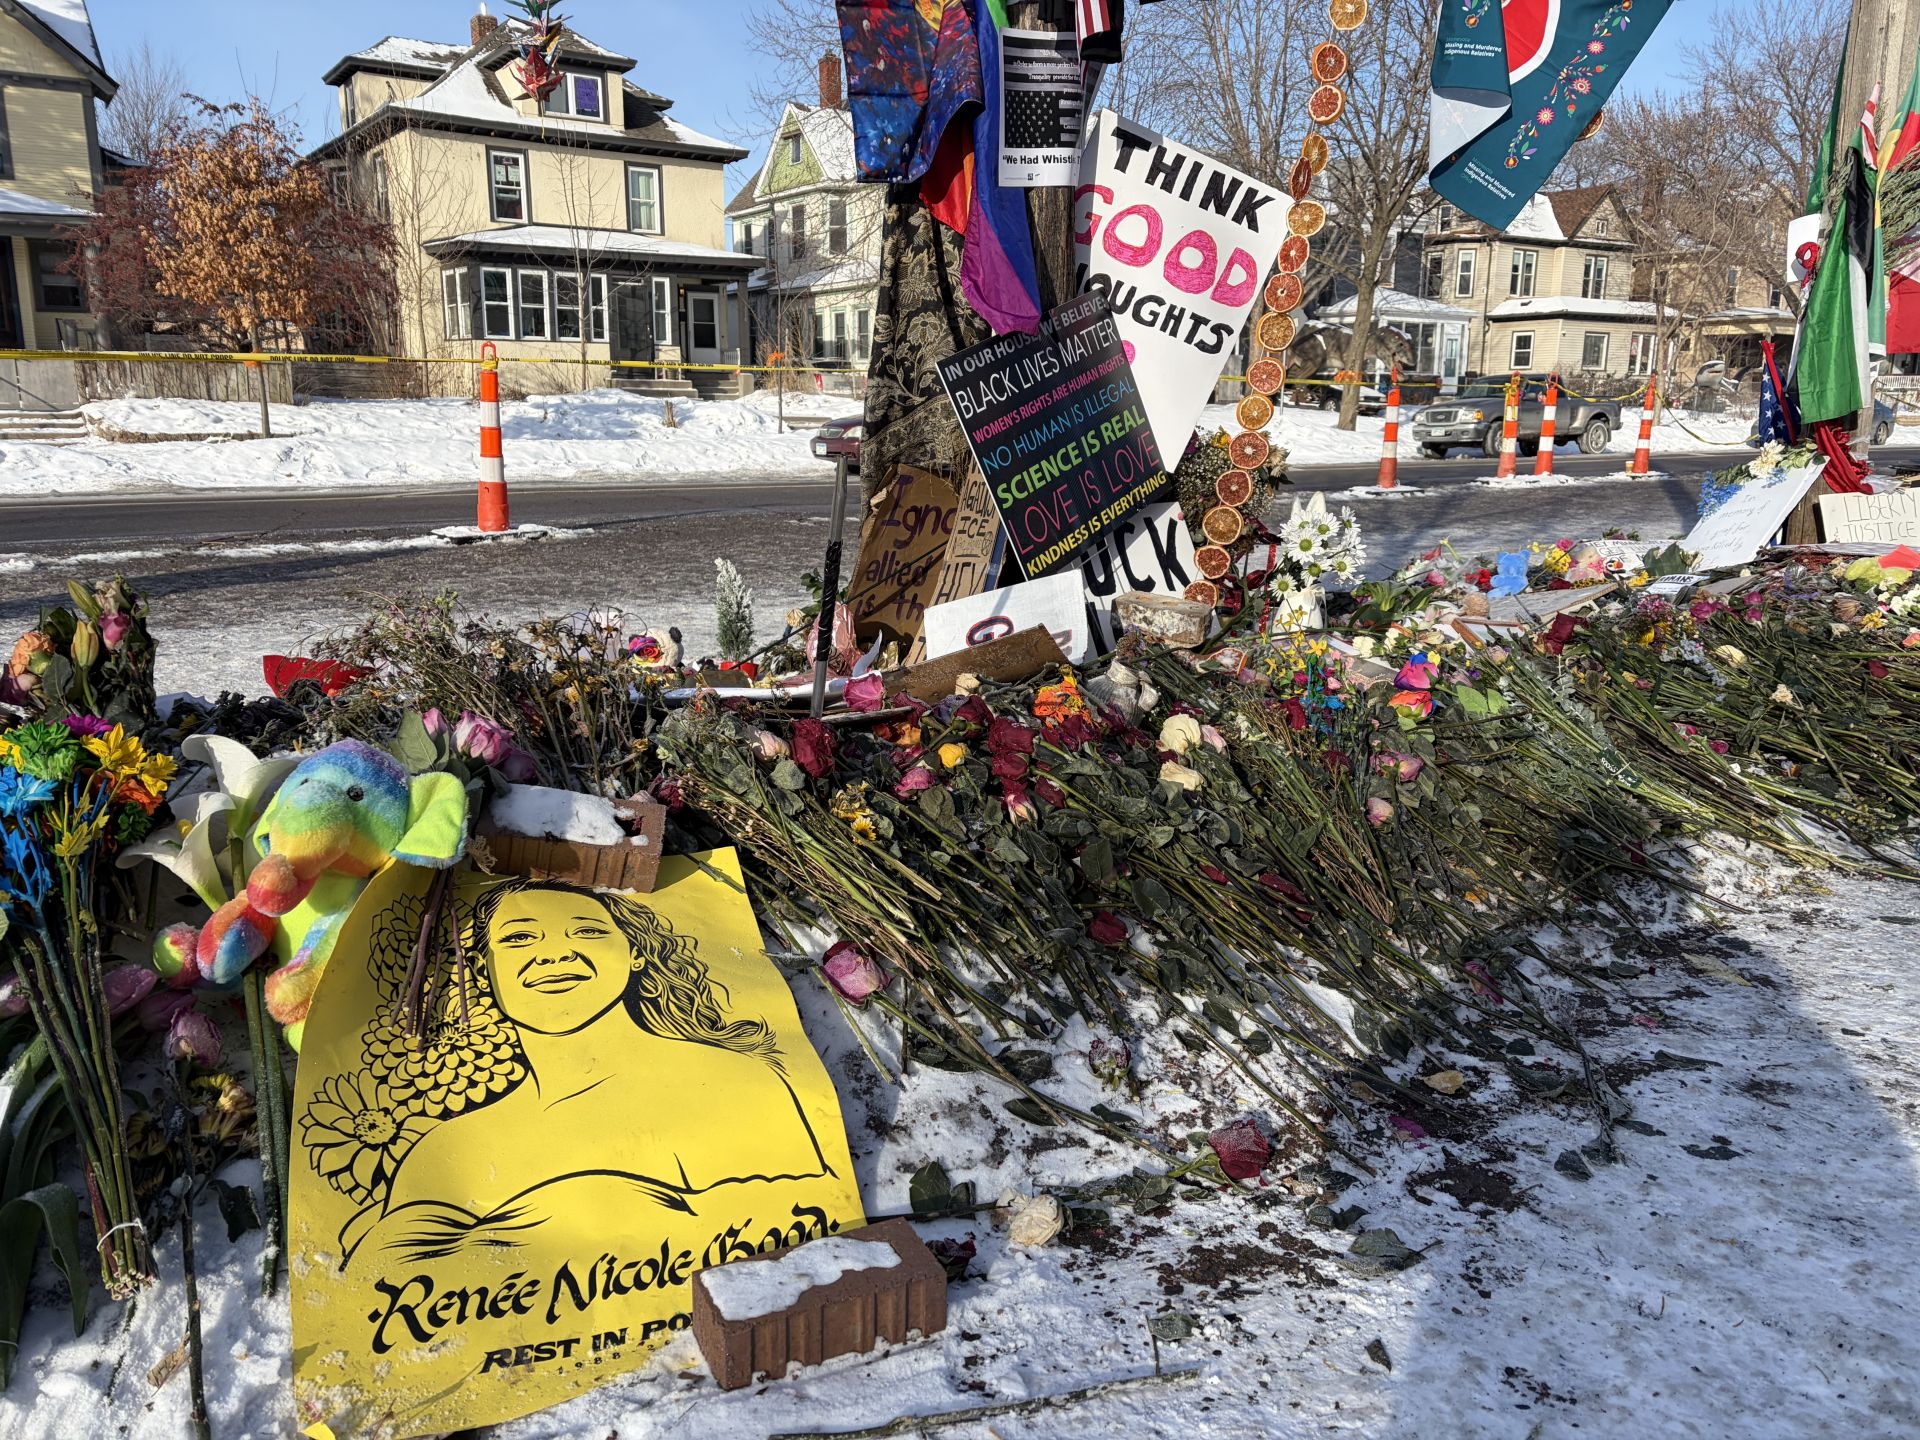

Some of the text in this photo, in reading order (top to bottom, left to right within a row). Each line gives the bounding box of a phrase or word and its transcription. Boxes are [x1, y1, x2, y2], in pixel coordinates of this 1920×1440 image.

[1475, 44, 1502, 52] Murdered
[1020, 155, 1040, 165] Had
[1111, 126, 1275, 233] THINK
[1464, 167, 1507, 200] Indigenous Relatives
[1468, 162, 1516, 198] Missing and Murdered
[1074, 184, 1258, 307] GOOD
[944, 362, 964, 382] IN
[964, 348, 995, 373] OUR
[1040, 317, 1062, 336] WE
[955, 318, 1118, 420] BLACK LIVES MATTER
[1020, 394, 1052, 421] RIGHTS
[1052, 385, 1069, 402] ARE
[1068, 367, 1101, 393] HUMAN
[1098, 353, 1126, 379] RIGHTS
[982, 445, 1012, 475] NO
[1013, 411, 1072, 458] HUMAN
[1071, 403, 1084, 425] IS
[1084, 376, 1135, 417] ILLEGAL
[996, 441, 1083, 509] SCIENCE
[1080, 429, 1101, 458] IS
[1100, 404, 1146, 446] REAL
[957, 515, 989, 539] ICE
[1008, 430, 1160, 556] LOVE IS LOVE
[1026, 470, 1168, 577] KINDNESS IS EVERYTHING
[1843, 491, 1918, 523] LIBERTY
[1081, 516, 1191, 597] UCK
[1843, 521, 1918, 543] JUSTICE
[371, 1269, 542, 1355] Renée
[545, 1236, 696, 1325] Nicole
[478, 1337, 581, 1375] REST
[591, 1326, 630, 1352] IN
